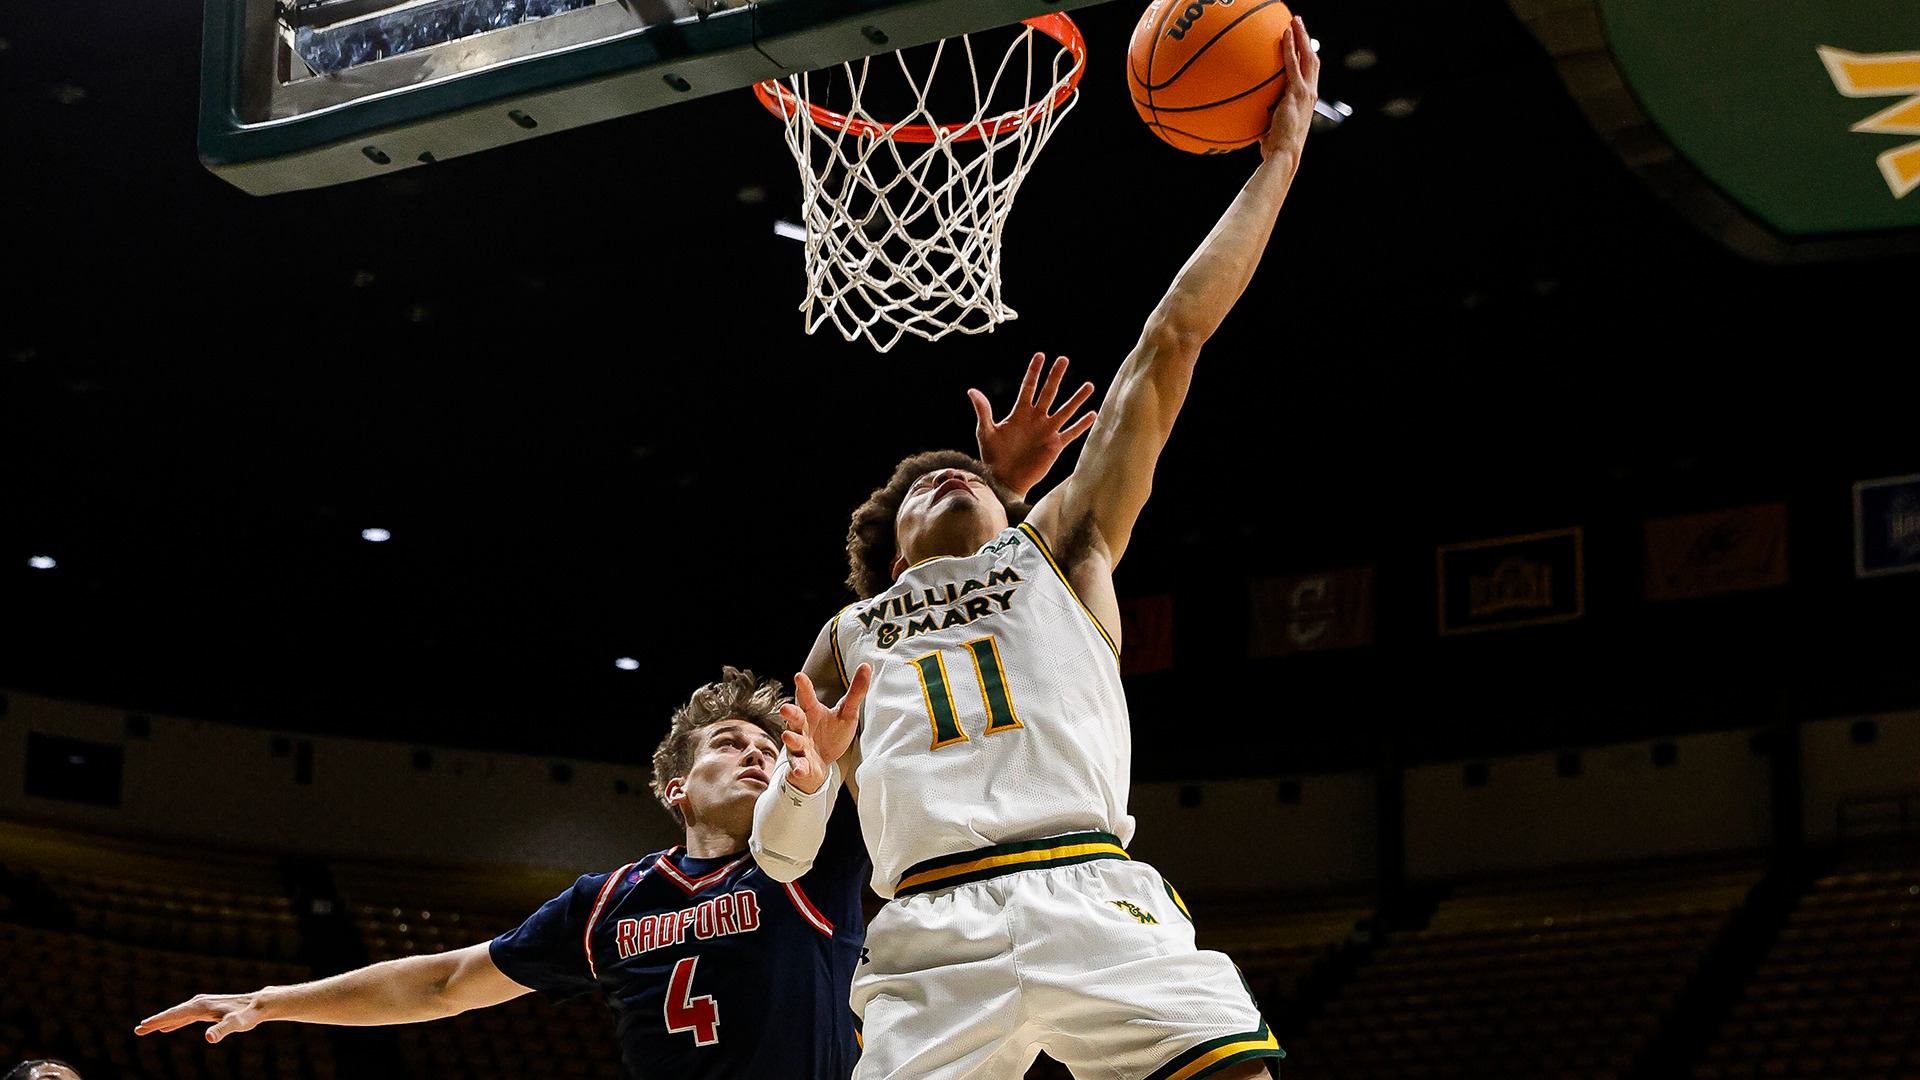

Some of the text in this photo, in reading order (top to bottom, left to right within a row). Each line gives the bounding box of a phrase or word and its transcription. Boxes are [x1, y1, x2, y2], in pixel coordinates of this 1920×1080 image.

[857, 566, 1023, 631] WILLIAM
[906, 634, 1024, 751] 11
[615, 889, 761, 960] RADFORD
[664, 955, 720, 1047] 4
